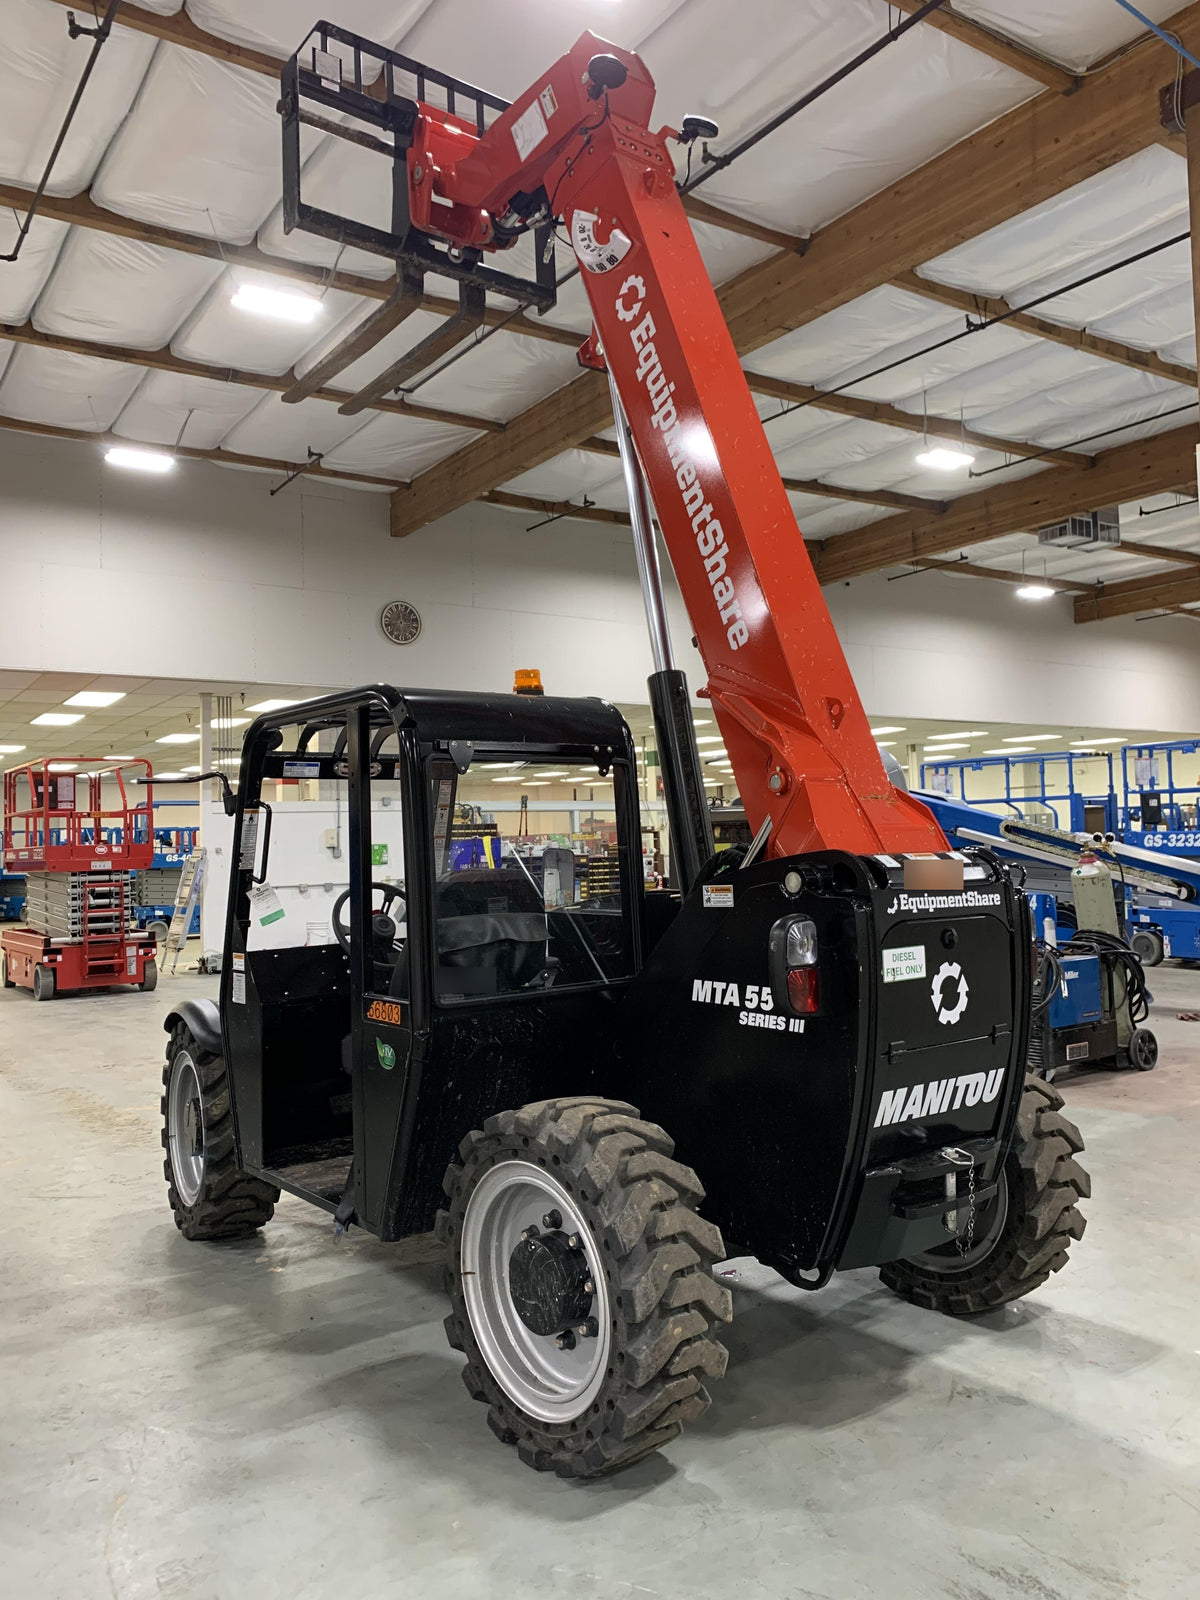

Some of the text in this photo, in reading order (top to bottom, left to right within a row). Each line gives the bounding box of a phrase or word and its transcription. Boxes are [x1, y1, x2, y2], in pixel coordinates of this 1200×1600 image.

[606, 254, 619, 266] 80
[630, 311, 749, 651] EquipmentShare
[1143, 833, 1200, 848] GS-3232
[899, 891, 1001, 913] EquipmentShare
[891, 951, 916, 963] DIESEL
[886, 964, 924, 978] FUEL ONLY
[692, 979, 774, 1011] MTA 55
[739, 1011, 805, 1033] SERIES III
[873, 1067, 1005, 1128] MANITOU
